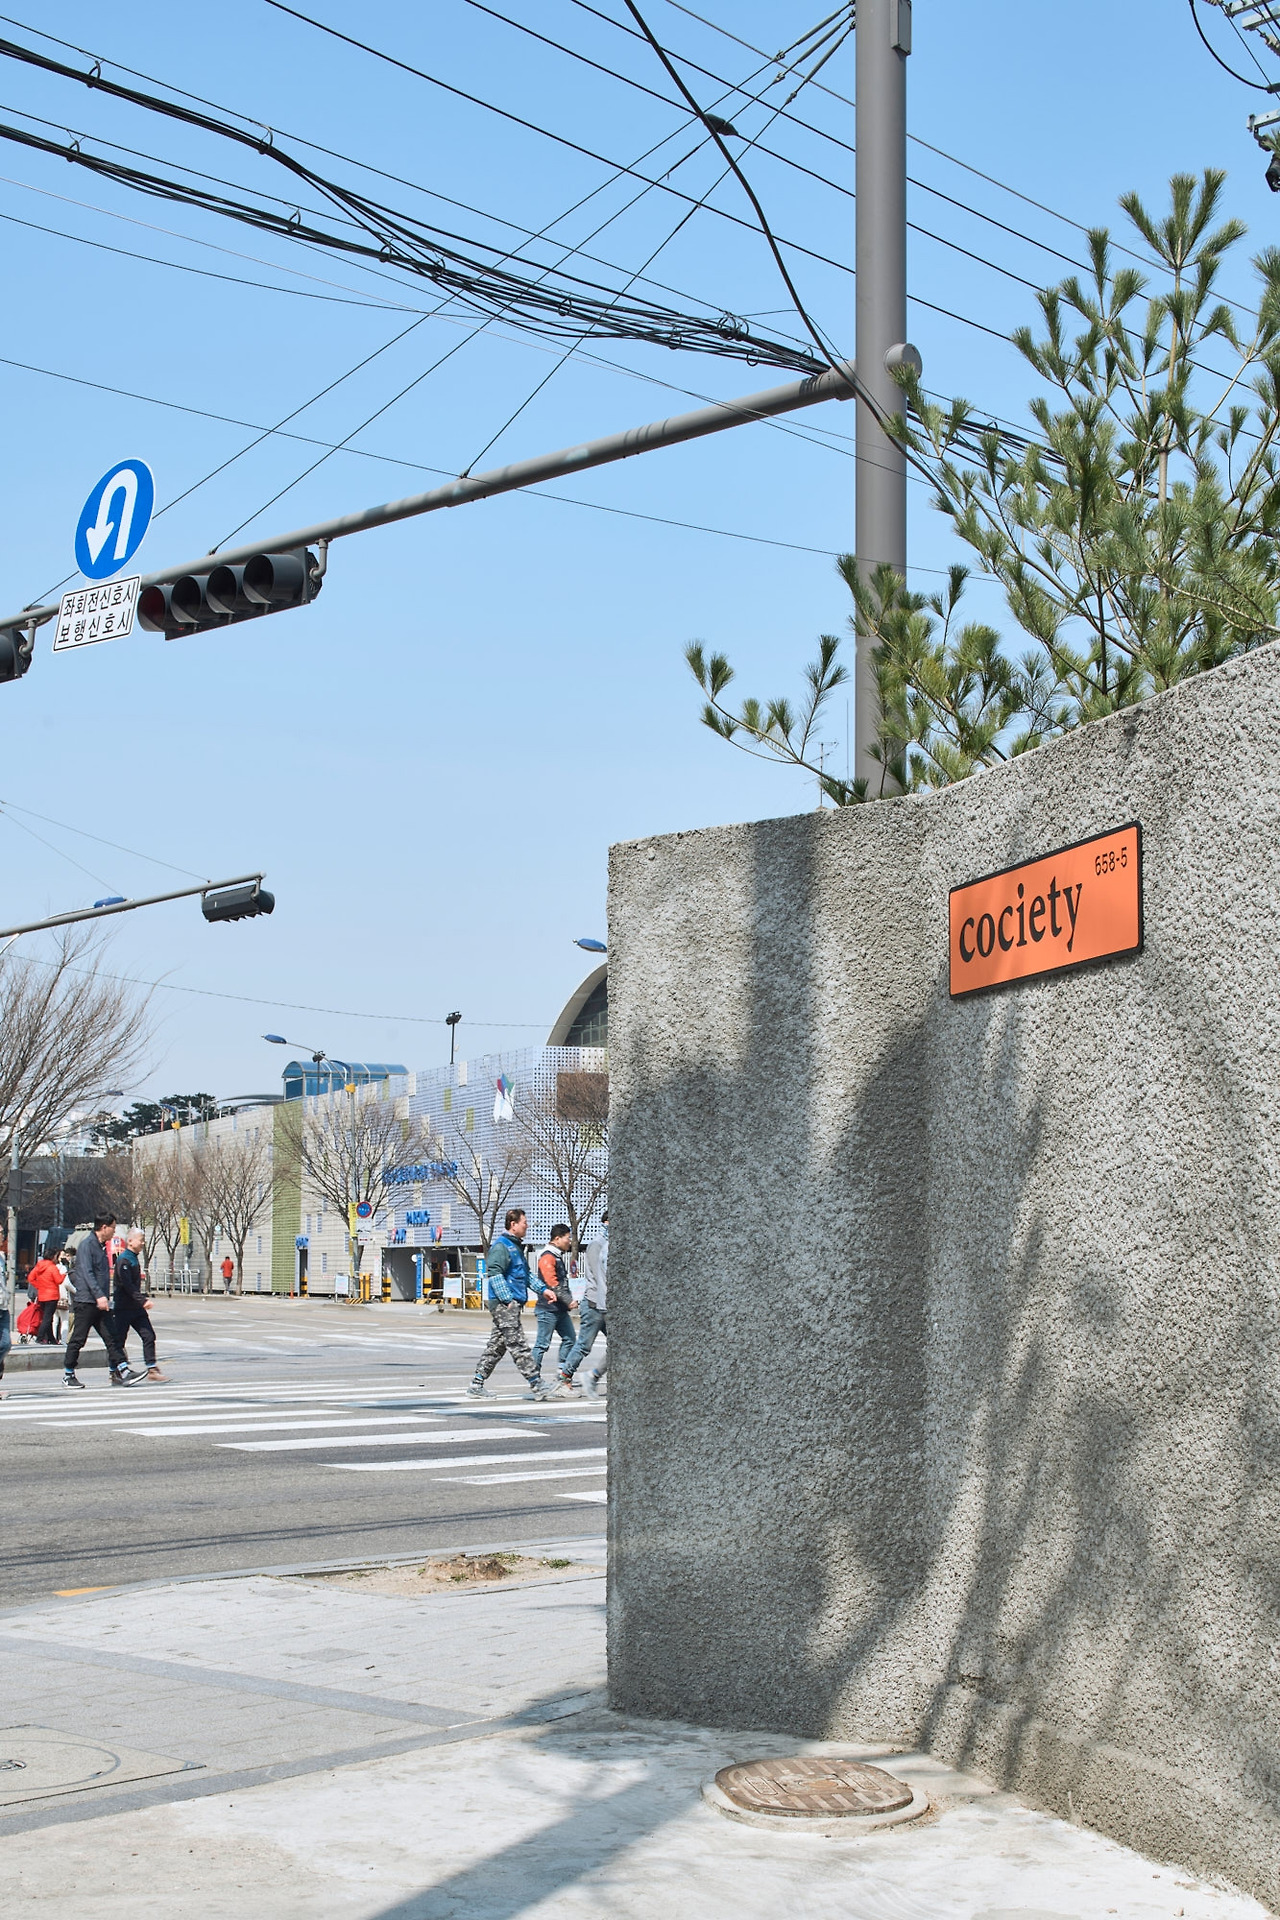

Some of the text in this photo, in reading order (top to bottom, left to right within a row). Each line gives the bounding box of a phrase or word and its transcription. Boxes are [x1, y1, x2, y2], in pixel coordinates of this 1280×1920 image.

[63, 581, 136, 618] 좌회전신호시
[57, 608, 132, 643] 보행신호시
[1094, 846, 1128, 876] 658-5
[959, 876, 1083, 963] cociety
